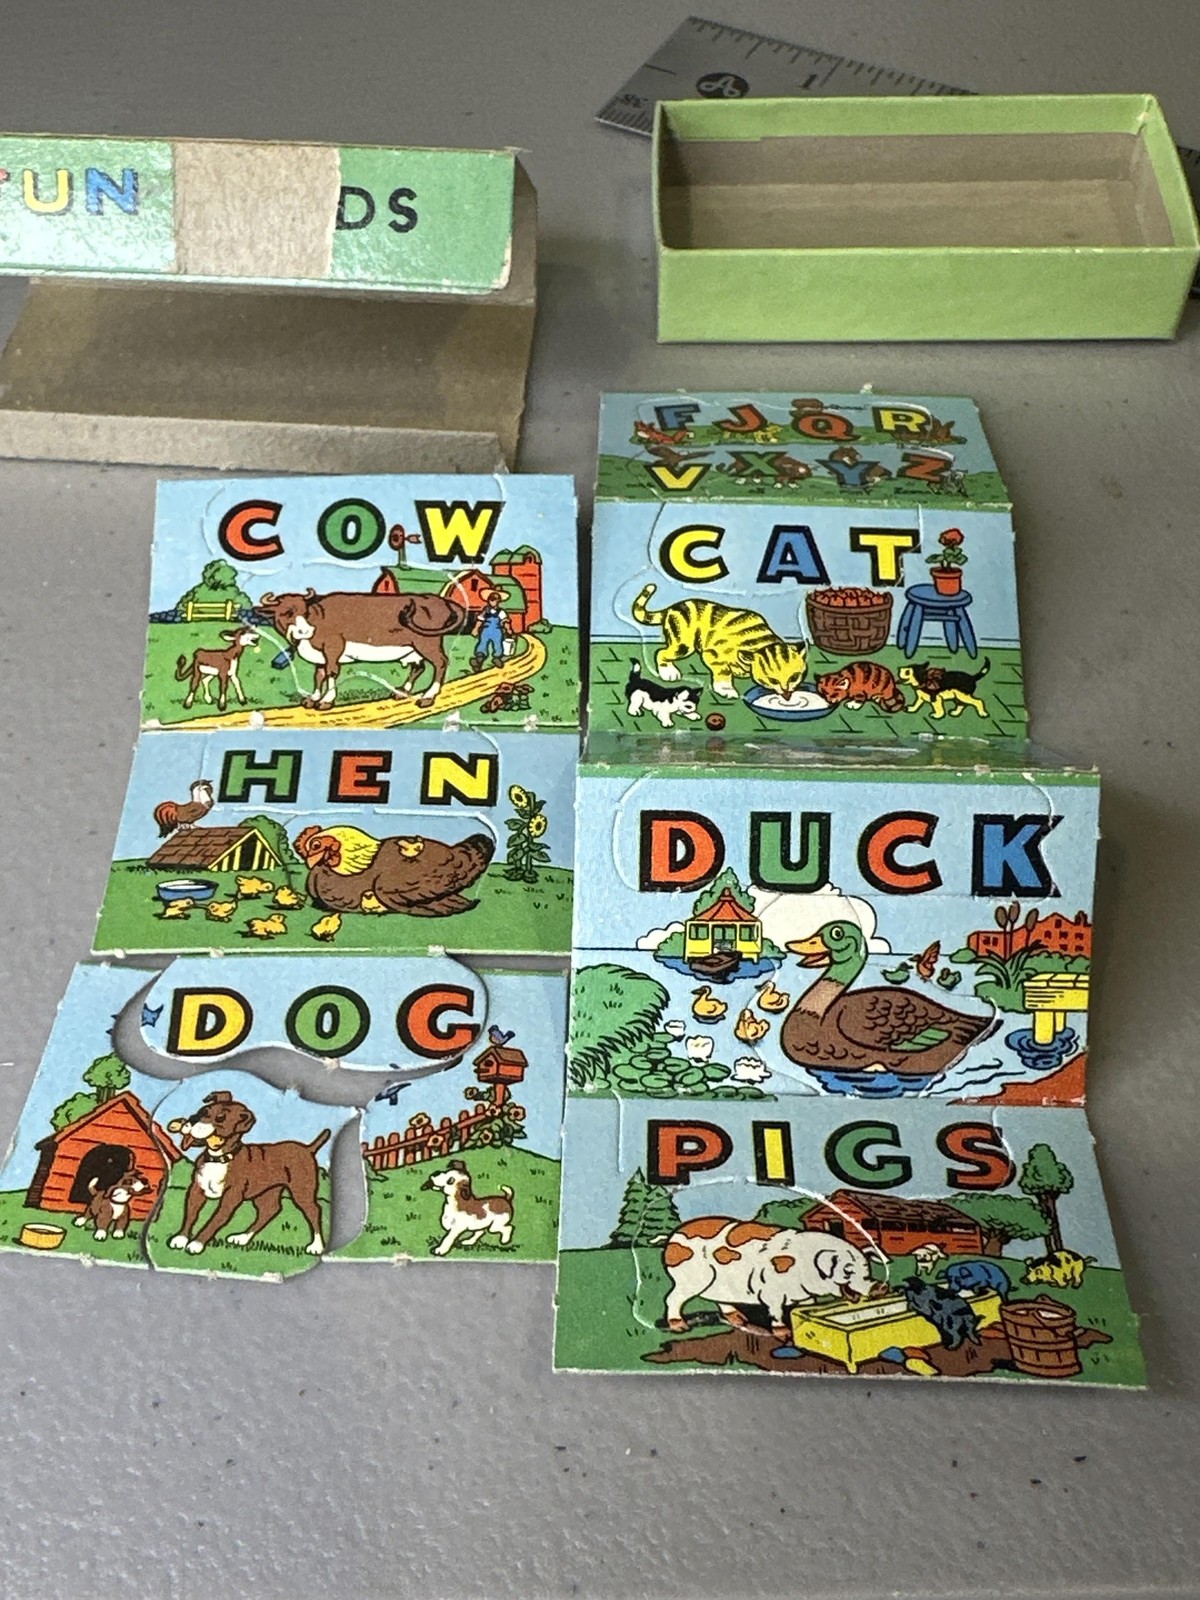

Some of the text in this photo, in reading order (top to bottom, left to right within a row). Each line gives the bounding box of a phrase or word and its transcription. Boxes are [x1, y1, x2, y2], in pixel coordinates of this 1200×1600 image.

[0, 167, 139, 216] UN
[654, 403, 931, 441] F J Q R
[644, 451, 953, 491] V X Y Z
[218, 498, 506, 563] COW
[659, 524, 922, 587] CAT
[218, 749, 499, 806] HEN
[639, 810, 1063, 897] DUCK
[167, 983, 481, 1059] DOG
[647, 1119, 1016, 1191] PIGS
